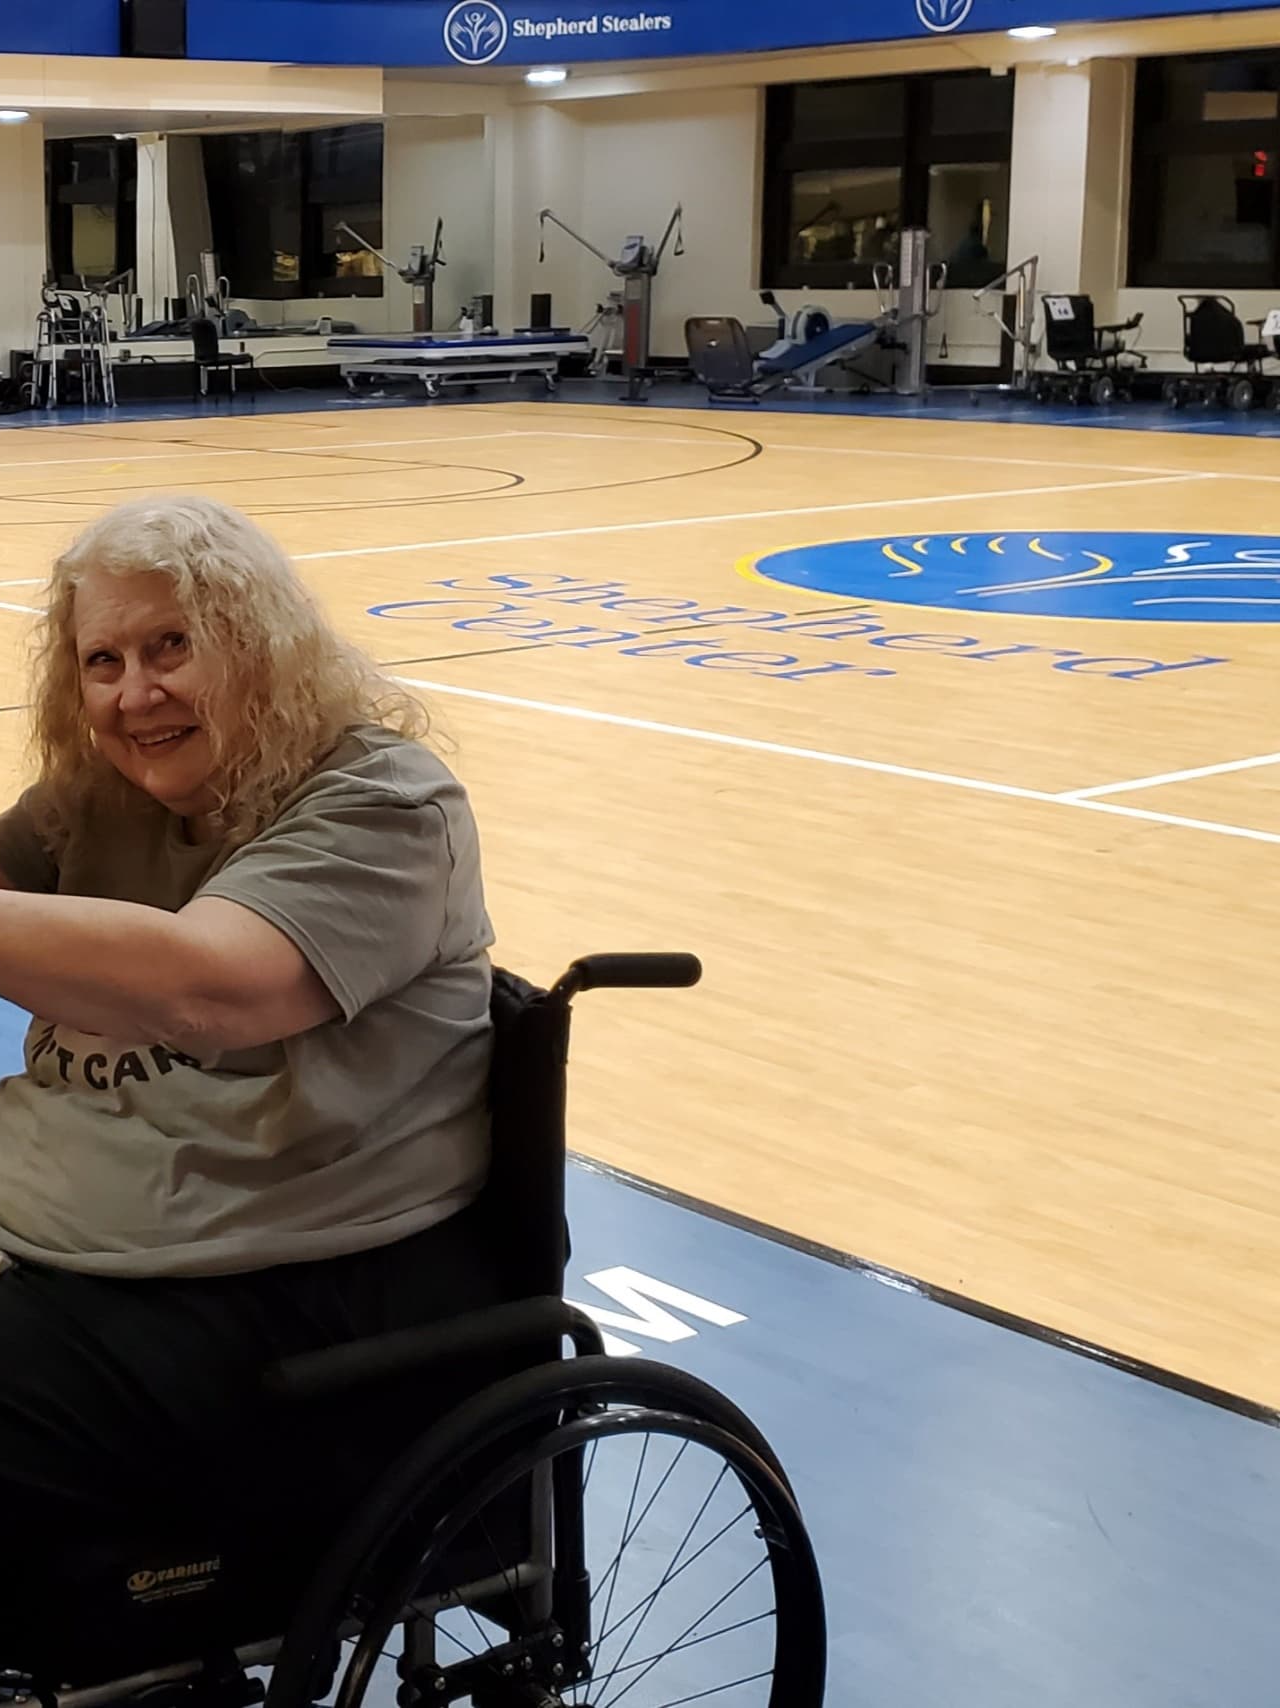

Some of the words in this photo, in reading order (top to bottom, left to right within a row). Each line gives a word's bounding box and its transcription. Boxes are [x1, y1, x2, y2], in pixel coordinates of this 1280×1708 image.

[512, 16, 598, 40] Shepherd
[602, 13, 672, 33] Stealers
[367, 599, 898, 682] Center
[424, 573, 1232, 680] Shepherd
